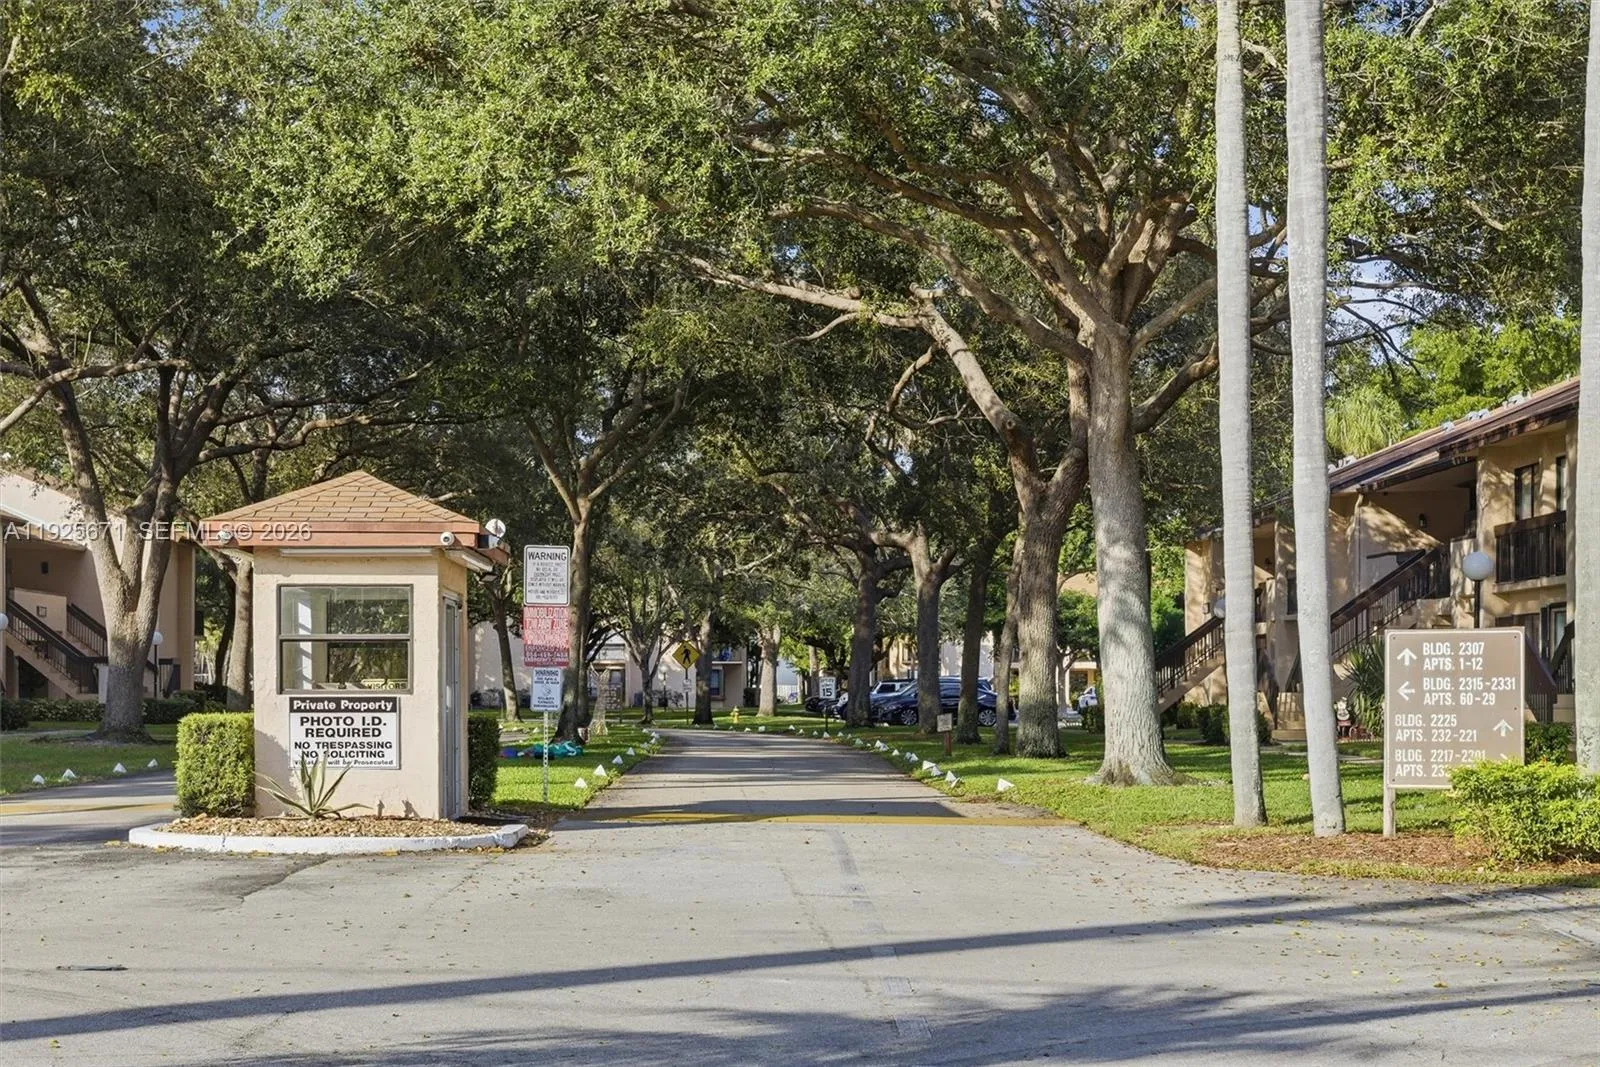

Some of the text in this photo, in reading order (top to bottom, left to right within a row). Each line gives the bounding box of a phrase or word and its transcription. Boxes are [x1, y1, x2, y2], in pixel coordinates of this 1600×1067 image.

[528, 551, 567, 561] WARNING
[1423, 642, 1485, 655] BLDG. 2307
[1423, 657, 1483, 670] APTS. 1-12
[1423, 677, 1516, 690] BLDG. 2315-2331
[822, 687, 833, 697] 15
[1423, 693, 1496, 705] APTS. 60-29
[293, 700, 393, 711] Private Property
[300, 716, 387, 726] PHOTO I.D.
[1395, 714, 1457, 727] BLDG. 2225
[305, 728, 382, 738] REQUIRED
[1395, 729, 1477, 742] APTS. 232-221
[294, 741, 393, 749] NO TRESPASSING
[302, 750, 318, 758] NO
[1395, 749, 1426, 762] BLDG.
[1395, 764, 1427, 777] APTS.
